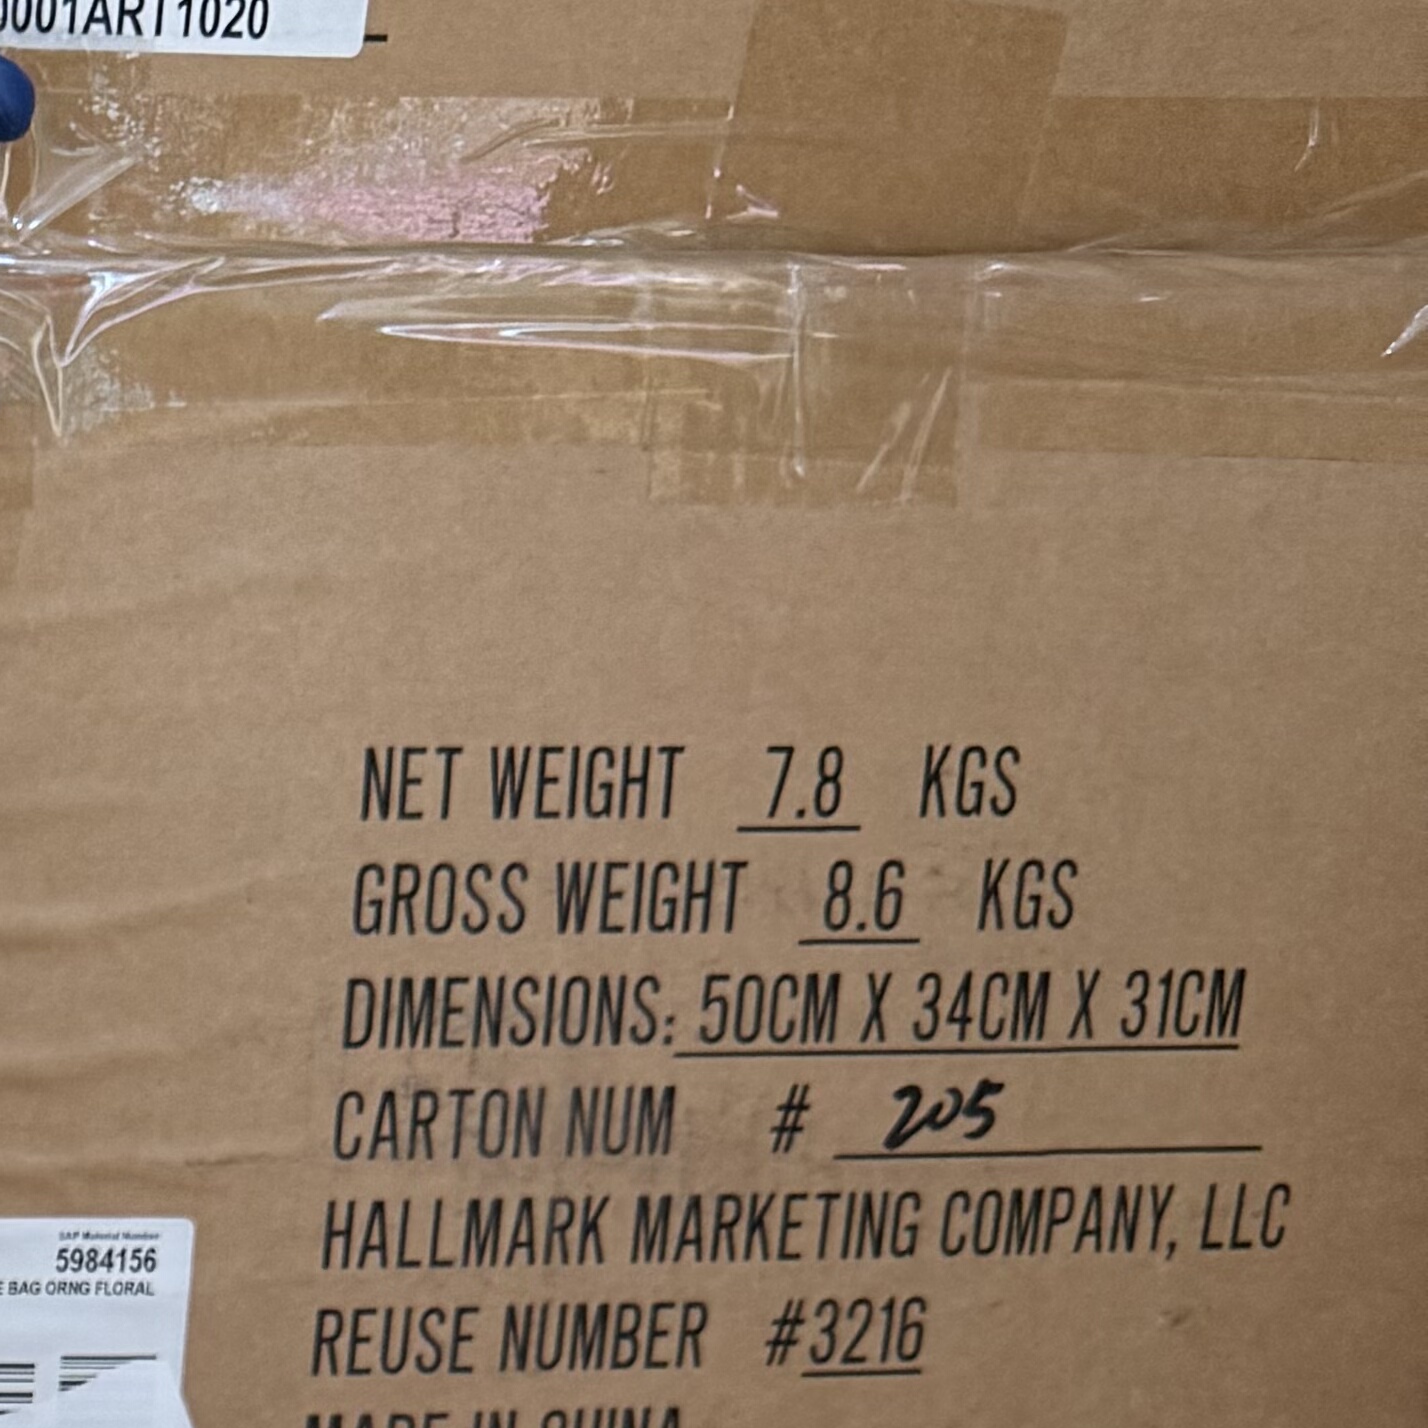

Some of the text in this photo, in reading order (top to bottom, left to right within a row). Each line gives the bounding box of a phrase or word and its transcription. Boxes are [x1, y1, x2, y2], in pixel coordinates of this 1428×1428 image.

[360, 745, 1022, 820] NET WEIGHT 7.8 KGS
[351, 858, 1080, 935] GROSS WEIGHT 8.6 KGS
[343, 968, 1248, 1050] DIMENSIONS: 50CM X 34CM X 31CM
[332, 1087, 547, 1160] CARTON
[564, 1085, 676, 1158] NUM
[883, 1080, 1005, 1149] 205
[56, 1248, 157, 1273] 5984156
[321, 1183, 1293, 1270] HALLMARK MARKETING COMPANY, LLC
[8, 1280, 41, 1296] BAG
[45, 1280, 91, 1296] ORNG
[95, 1280, 154, 1296] FLORAL
[311, 1297, 928, 1377] REUSE NUMBER #3216
